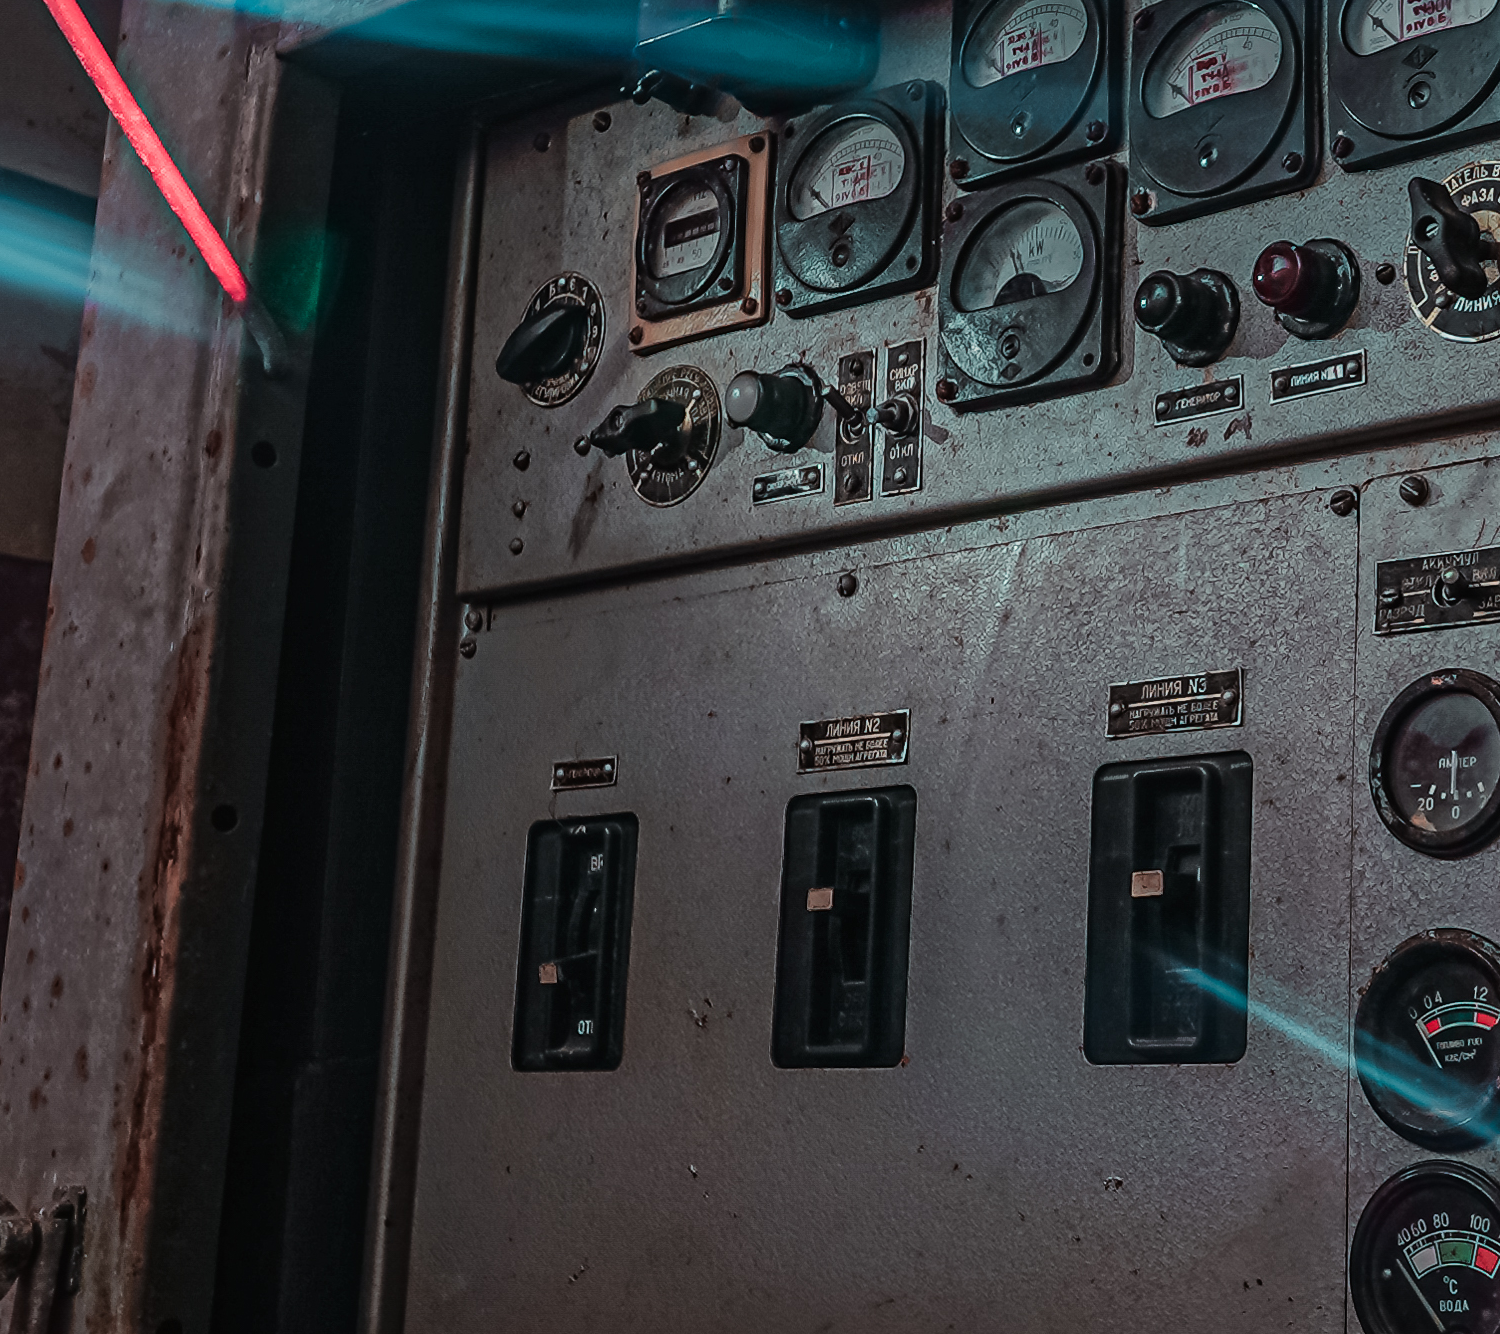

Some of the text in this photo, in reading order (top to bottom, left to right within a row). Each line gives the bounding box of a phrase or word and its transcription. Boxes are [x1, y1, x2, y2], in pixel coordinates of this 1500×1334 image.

[1461, 188, 1494, 207] ФАЗА
[1028, 239, 1044, 259] kW
[1175, 391, 1221, 411] ГЕНЕРАТОР
[841, 451, 864, 467] ОТКЛ
[890, 443, 914, 459] ОТКЛ
[1141, 680, 1182, 699] ЛИНИЯ
[826, 717, 880, 737] ЛИНИЯ N2
[1418, 797, 1434, 811] 20
[1452, 805, 1460, 819] 0
[1398, 1212, 1490, 1246] 40 60 80 100
[1439, 1299, 1470, 1313] ВОДА
